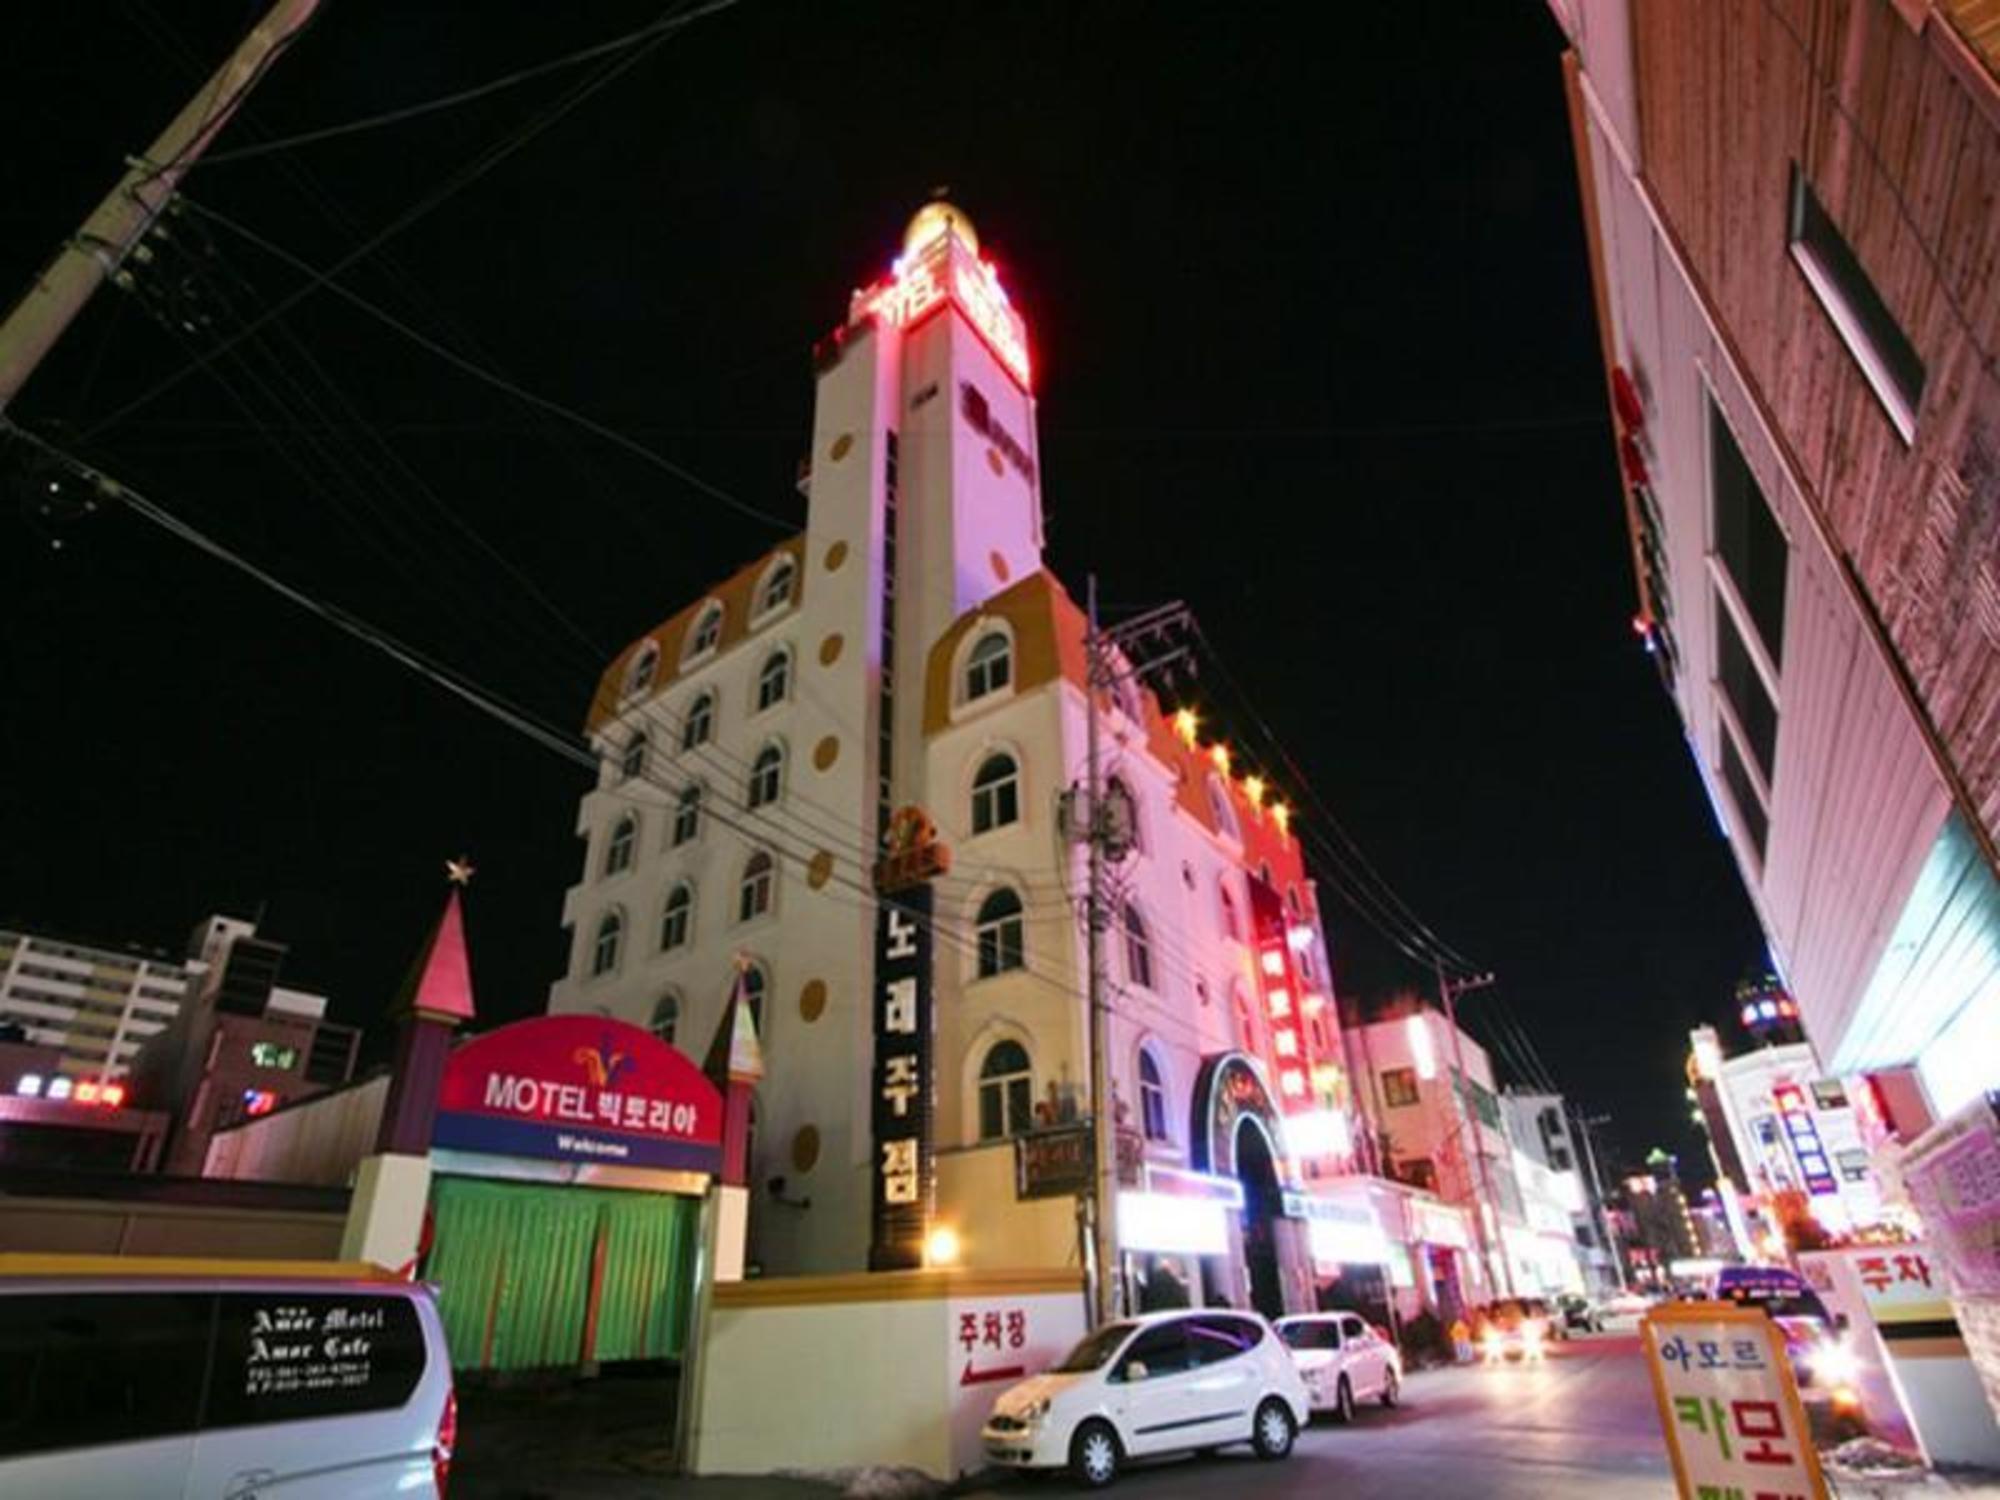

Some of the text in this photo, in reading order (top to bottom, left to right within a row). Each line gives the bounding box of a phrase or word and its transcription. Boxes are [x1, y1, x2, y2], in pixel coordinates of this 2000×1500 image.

[881, 908, 919, 1203] 노래주점
[484, 1073, 698, 1134] MOTEL 빅토리아
[557, 1134, 628, 1157] Welcome
[959, 1309, 1026, 1351] 주차장
[1661, 1335, 1767, 1371] 아모르
[1673, 1396, 1794, 1465] 카모
